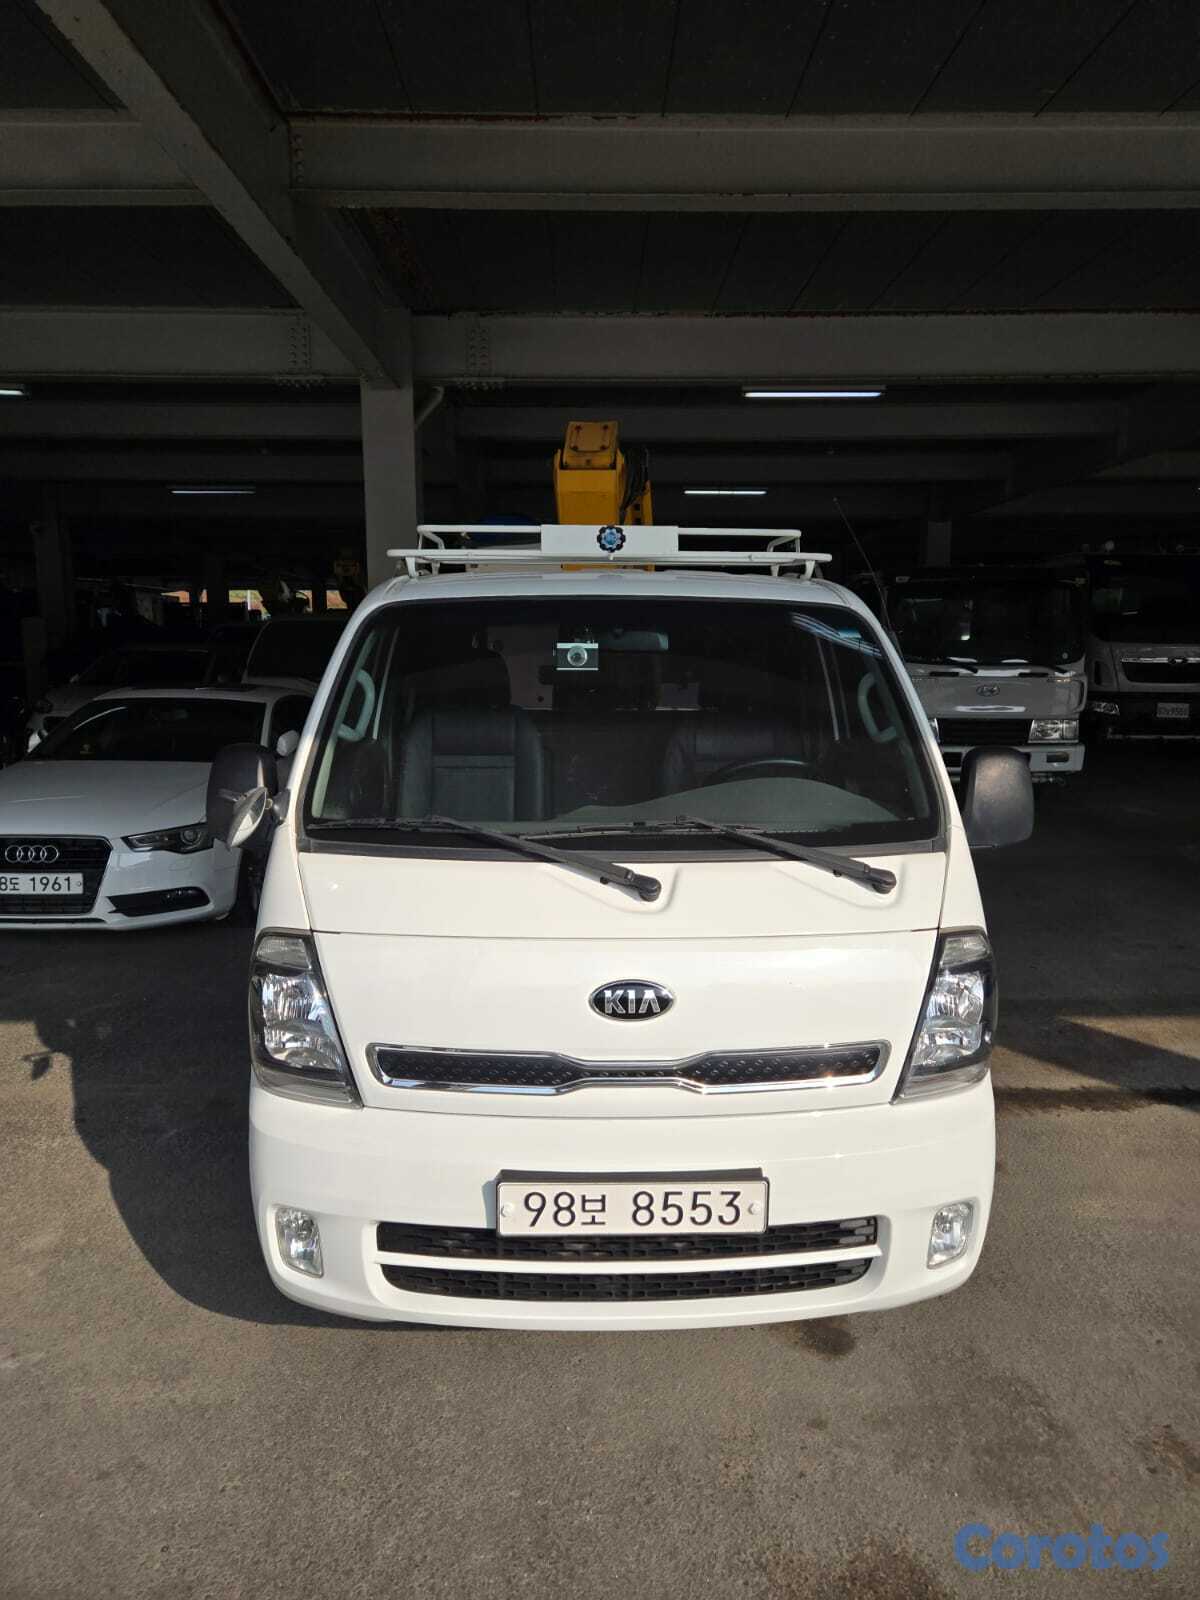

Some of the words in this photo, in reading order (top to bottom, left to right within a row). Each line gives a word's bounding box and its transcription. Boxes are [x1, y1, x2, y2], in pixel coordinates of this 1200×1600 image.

[29, 876, 71, 892] 1961
[604, 989, 661, 1014] KIA
[523, 1191, 606, 1227] 98보
[631, 1190, 741, 1227] 8553
